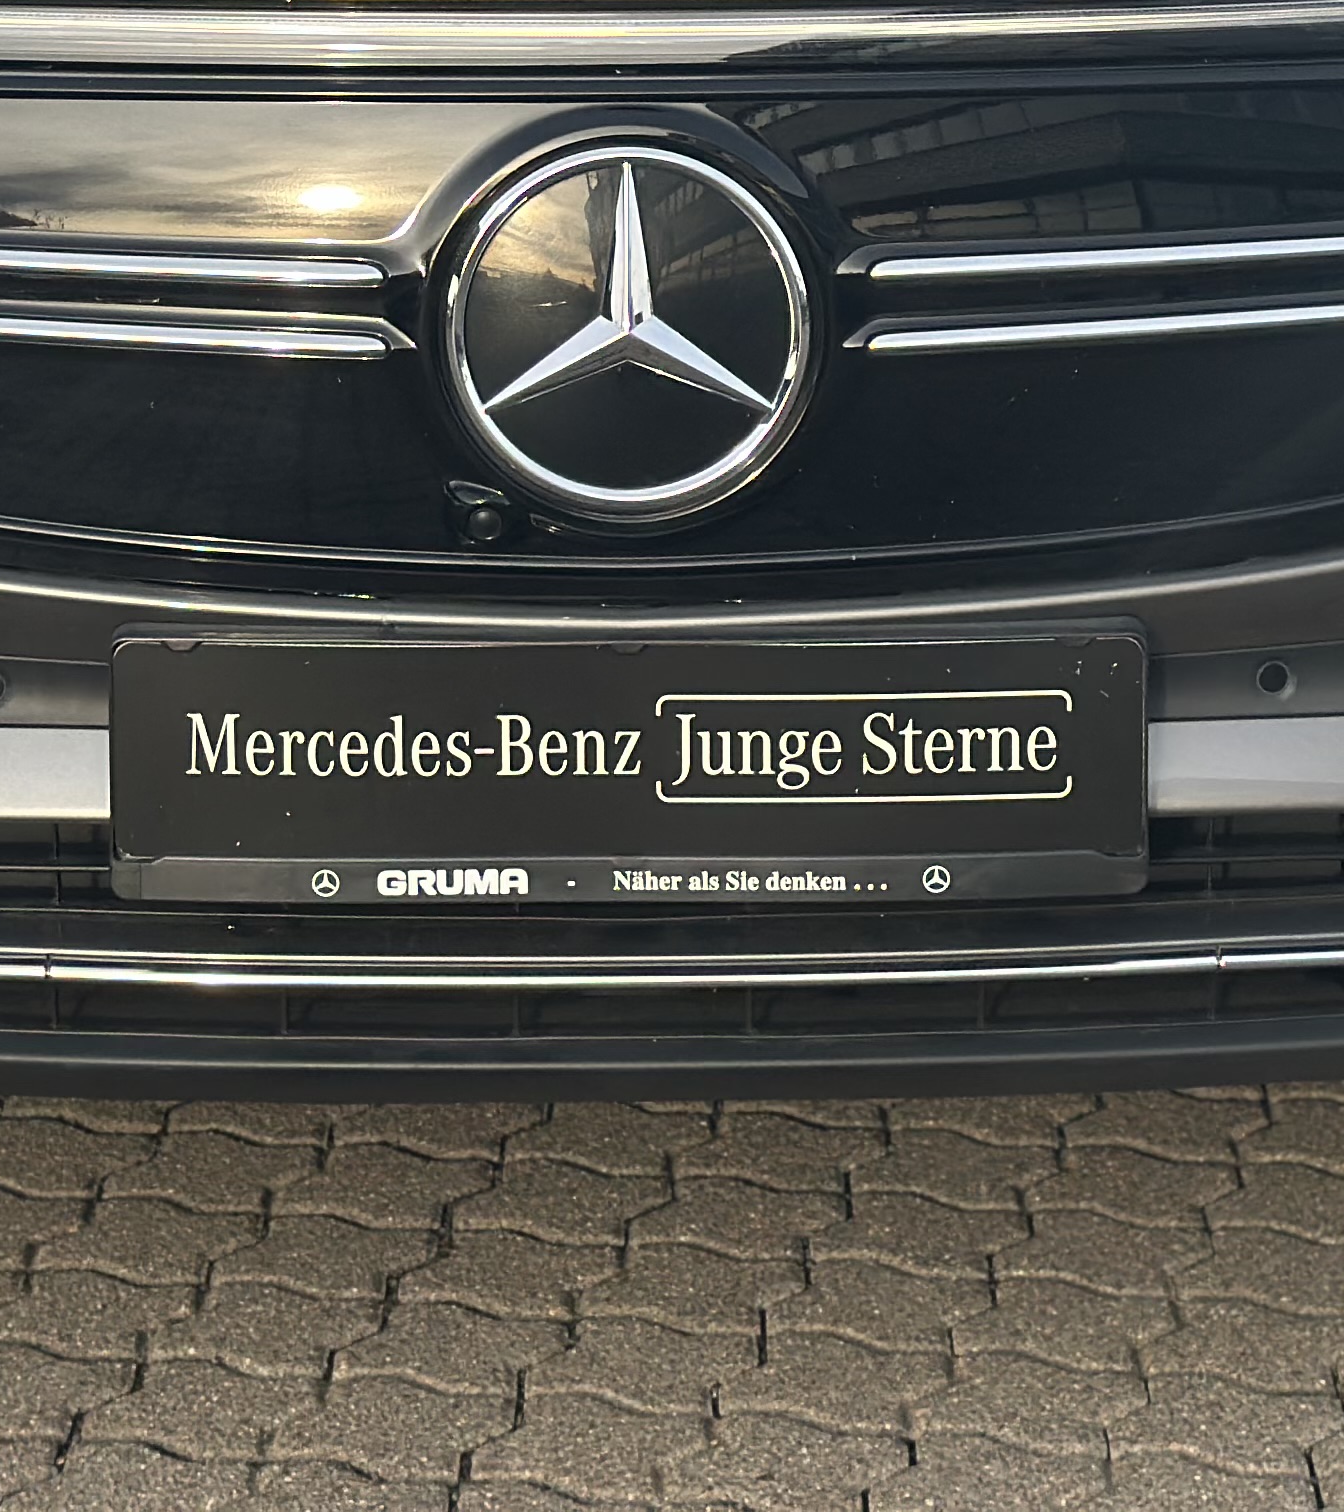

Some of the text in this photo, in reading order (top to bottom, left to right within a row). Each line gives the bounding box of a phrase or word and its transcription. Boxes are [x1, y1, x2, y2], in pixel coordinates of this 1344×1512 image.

[185, 712, 1058, 791] Mercedes-Benz Junge Sterne
[376, 867, 529, 897] GRUMA
[612, 869, 683, 892] Näher
[687, 870, 720, 892] als
[725, 870, 760, 892] Sie
[764, 870, 847, 892] denken
